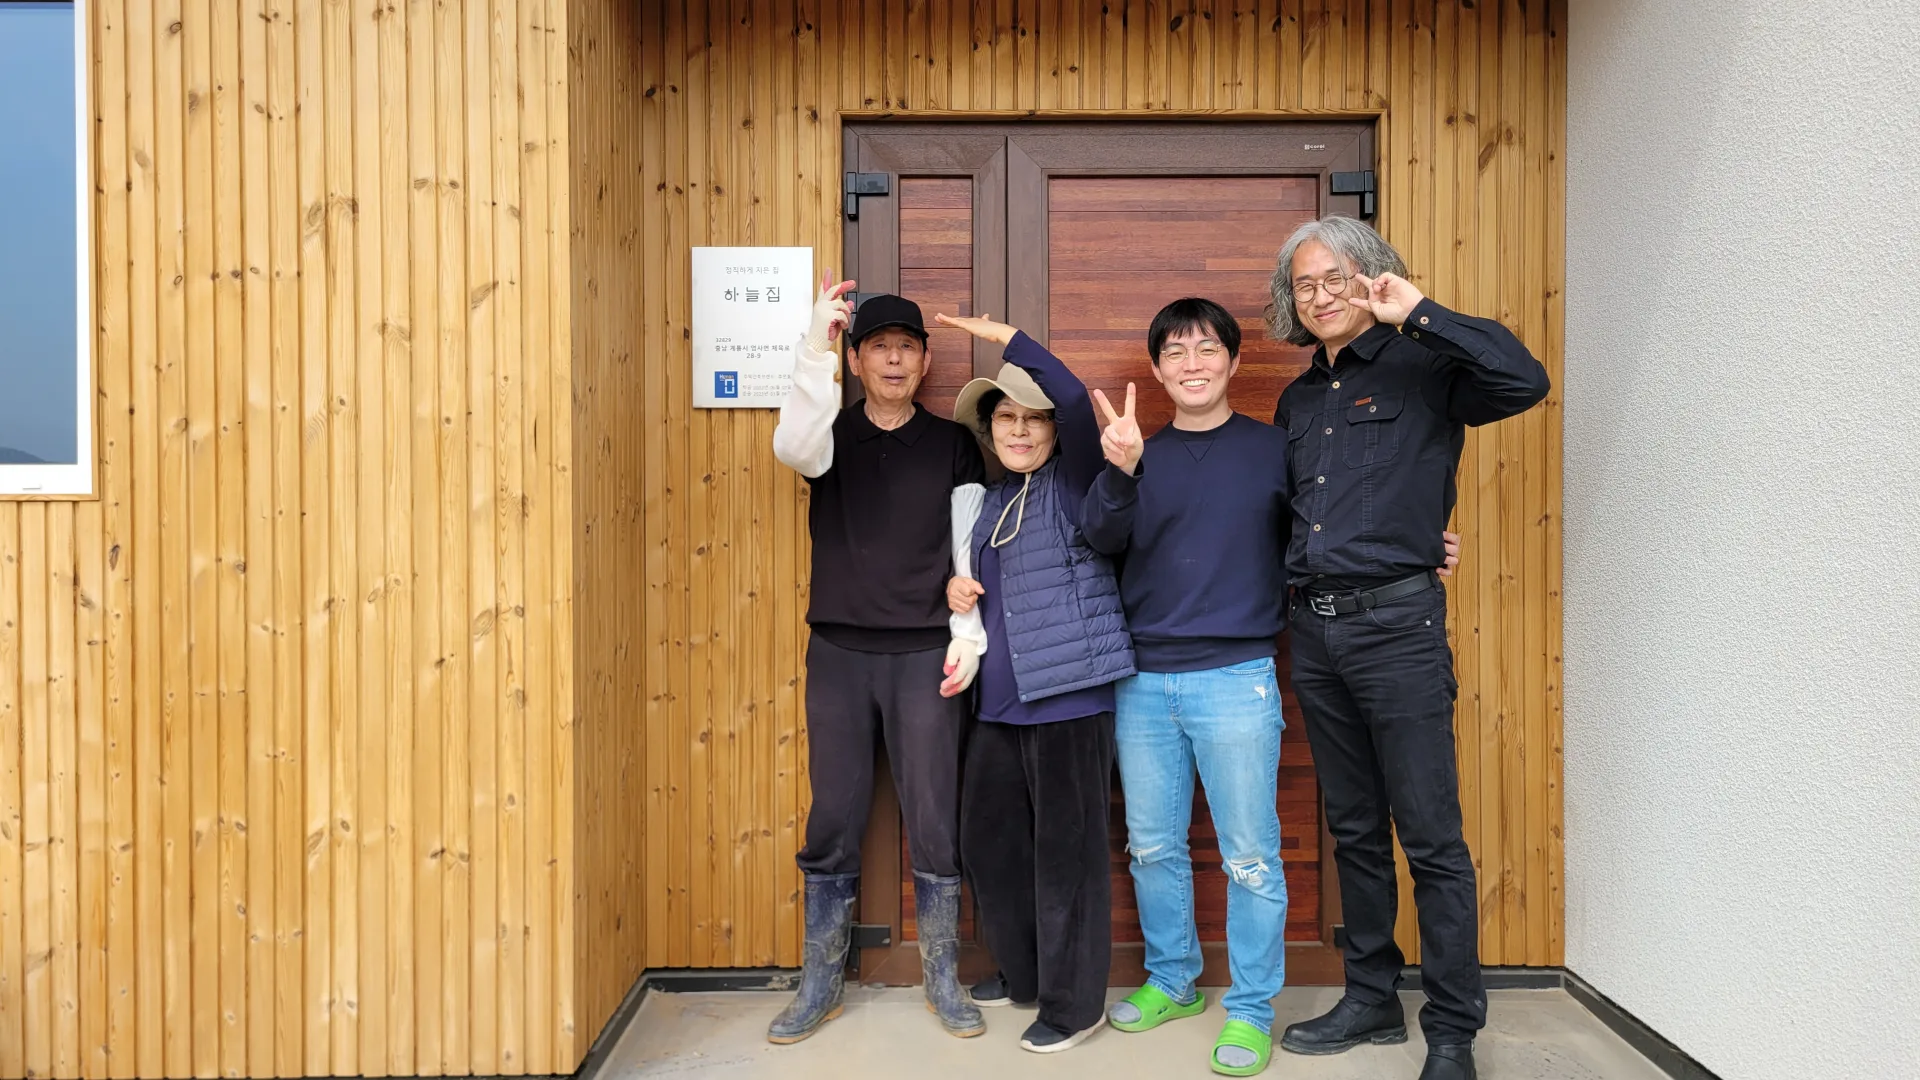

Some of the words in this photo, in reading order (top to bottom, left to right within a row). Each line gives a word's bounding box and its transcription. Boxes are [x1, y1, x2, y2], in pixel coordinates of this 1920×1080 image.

[725, 266, 754, 275] 정직하게
[755, 266, 771, 275] 지은
[772, 266, 780, 275] 집
